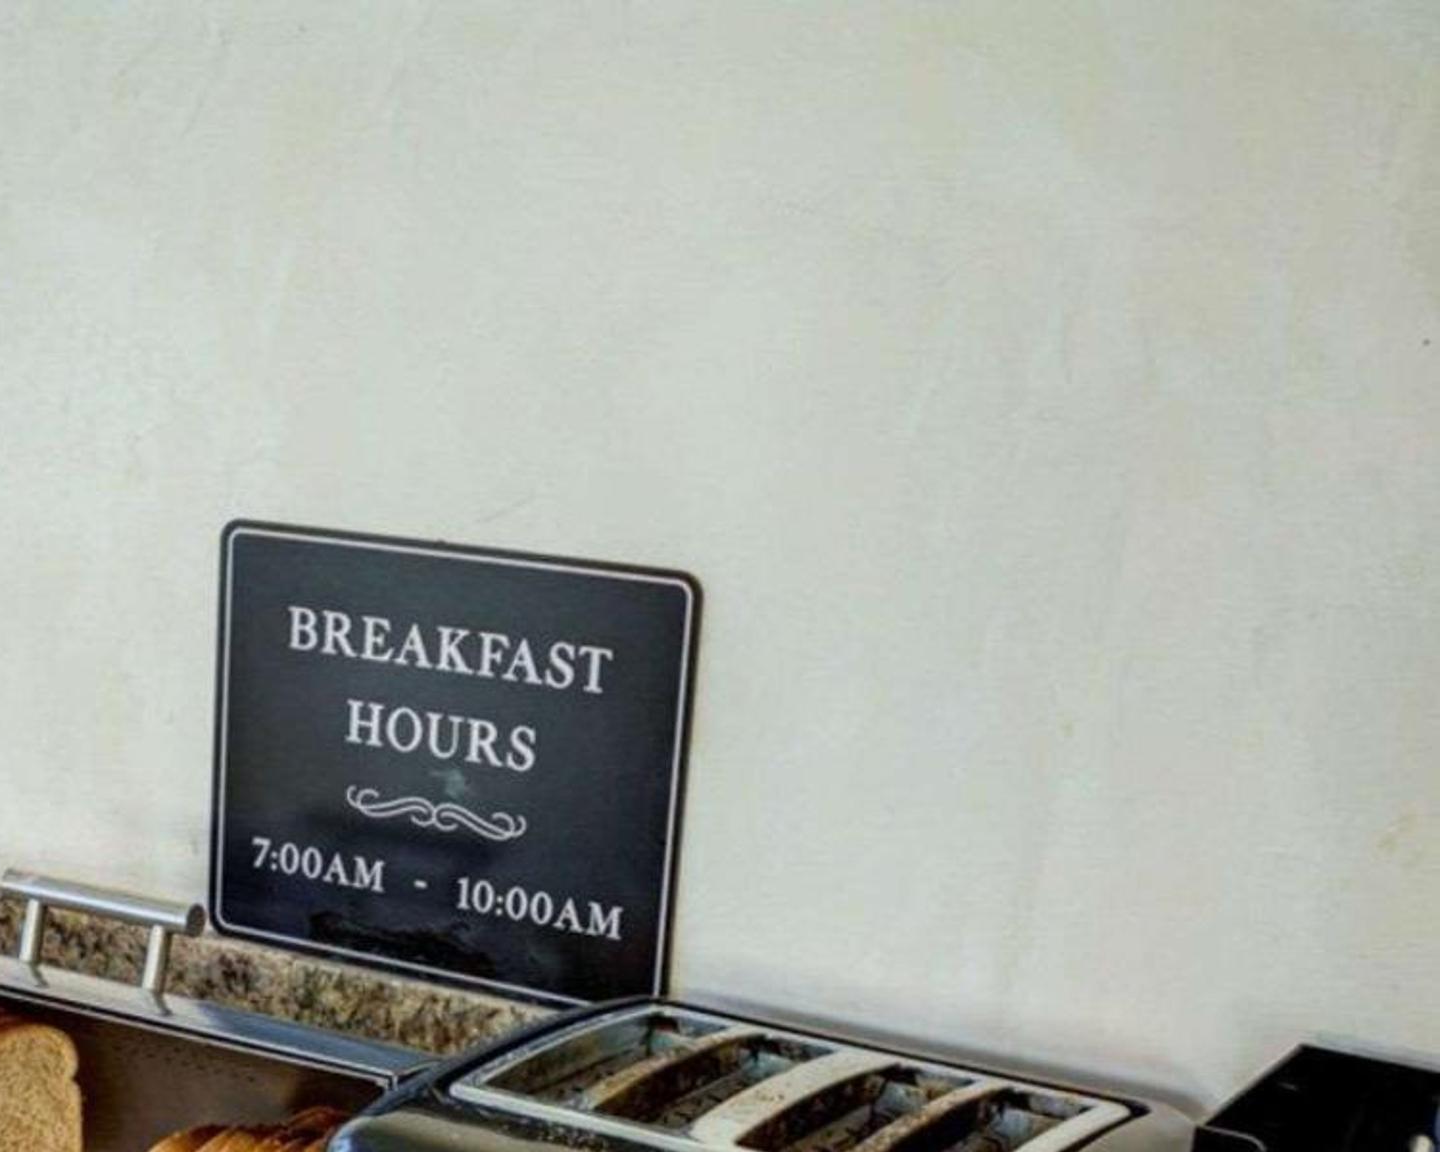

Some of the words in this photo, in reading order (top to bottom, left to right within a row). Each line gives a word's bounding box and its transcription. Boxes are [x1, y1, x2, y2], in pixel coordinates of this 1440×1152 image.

[287, 605, 614, 694] BREAKFAST
[345, 698, 537, 772] HOURS
[252, 836, 386, 893] 7:00AM
[456, 877, 623, 941] 10:00AM
